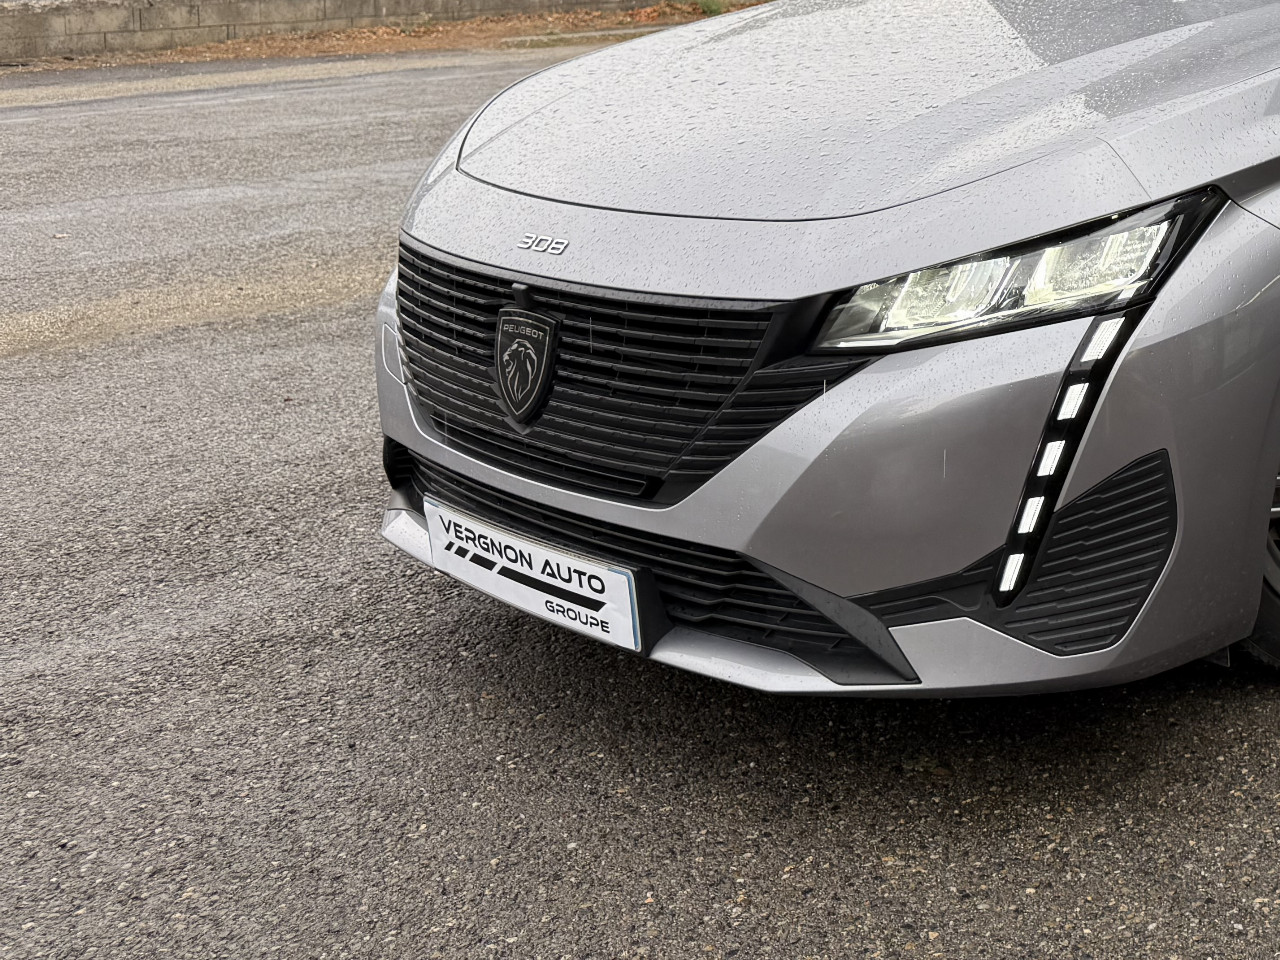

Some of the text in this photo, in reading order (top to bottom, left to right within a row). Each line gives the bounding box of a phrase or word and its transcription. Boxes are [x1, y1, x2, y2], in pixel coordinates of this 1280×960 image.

[516, 232, 570, 255] 308
[503, 324, 544, 340] PEUGEOT
[438, 514, 606, 595] VERGNON AUTO
[544, 599, 611, 634] GROUPE
